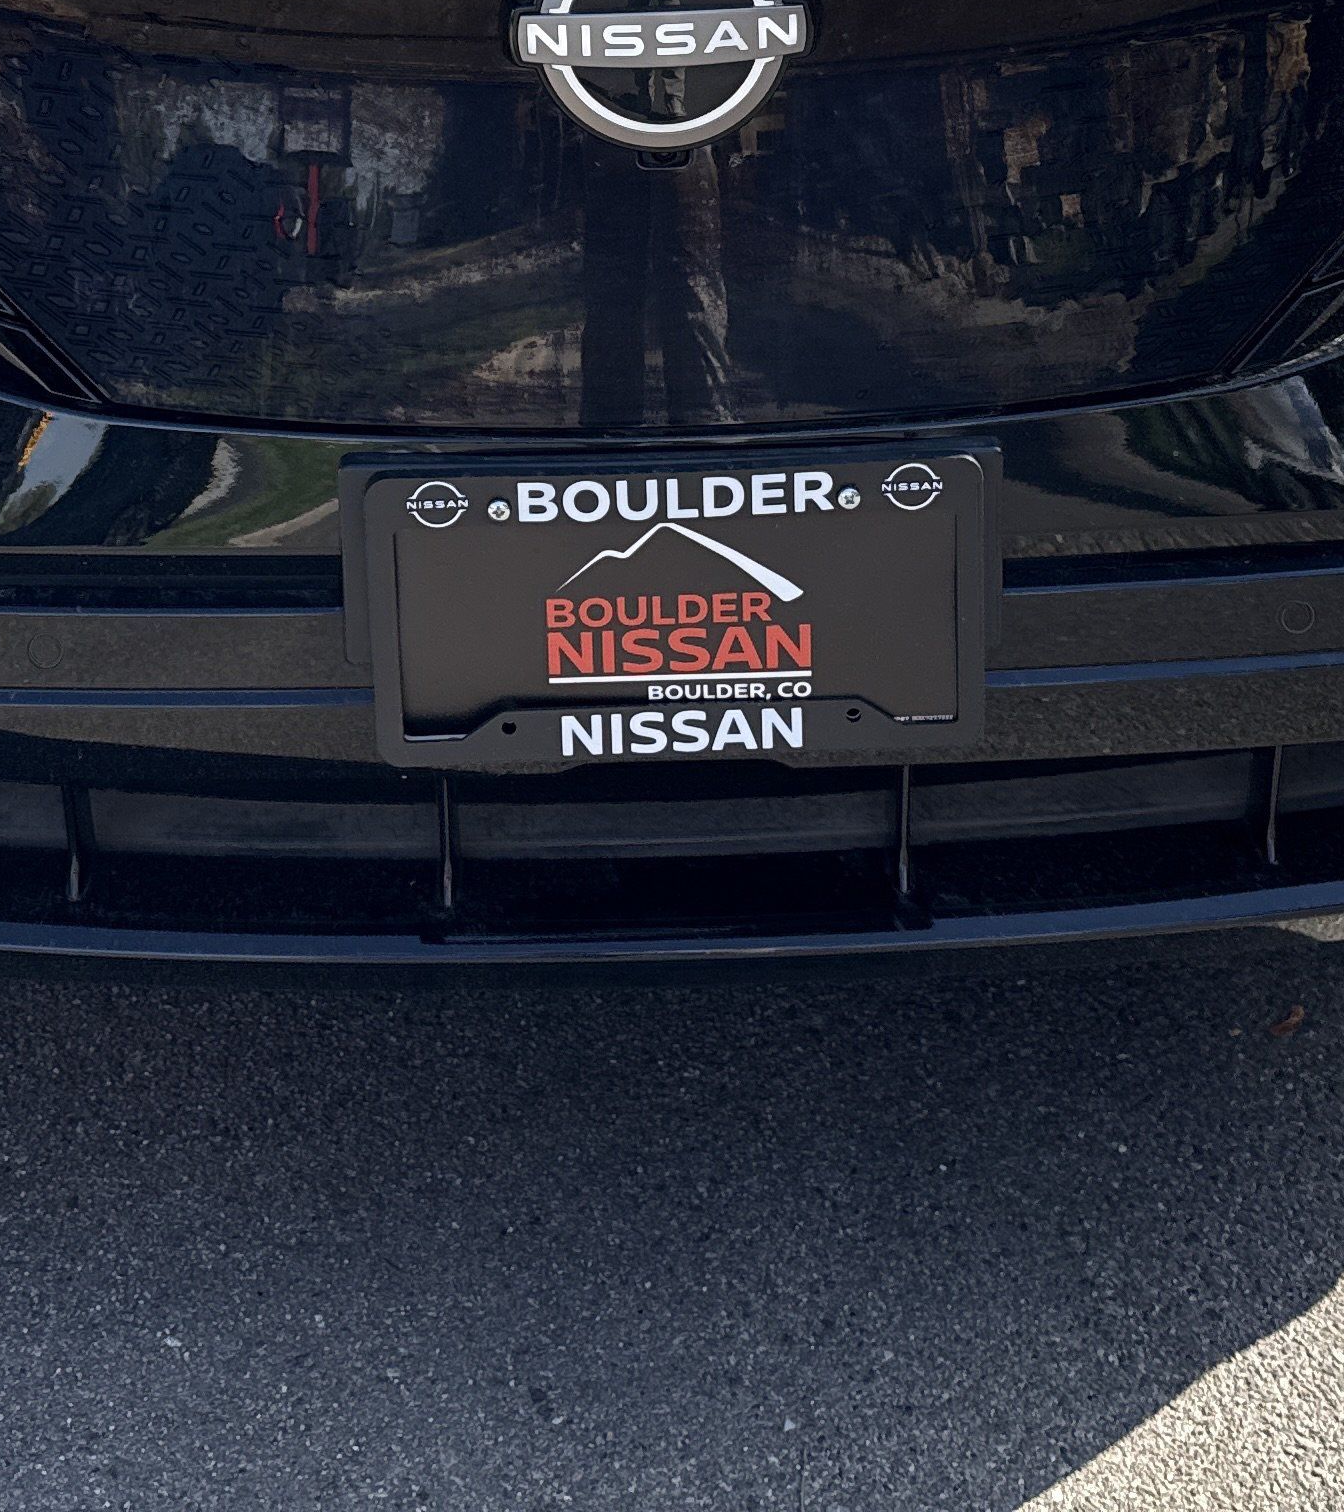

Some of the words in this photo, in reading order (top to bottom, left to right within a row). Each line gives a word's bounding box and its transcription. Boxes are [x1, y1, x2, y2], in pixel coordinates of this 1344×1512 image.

[525, 13, 798, 58] NISSAN
[406, 498, 469, 510] NISSAN
[516, 471, 835, 523] BOULDER
[881, 480, 943, 492] NISSAN
[545, 592, 772, 628] BOULDER
[547, 623, 812, 675] NISSAN
[647, 683, 771, 701] BOULDER,
[777, 681, 812, 698] CO
[561, 707, 804, 757] NISSAN
